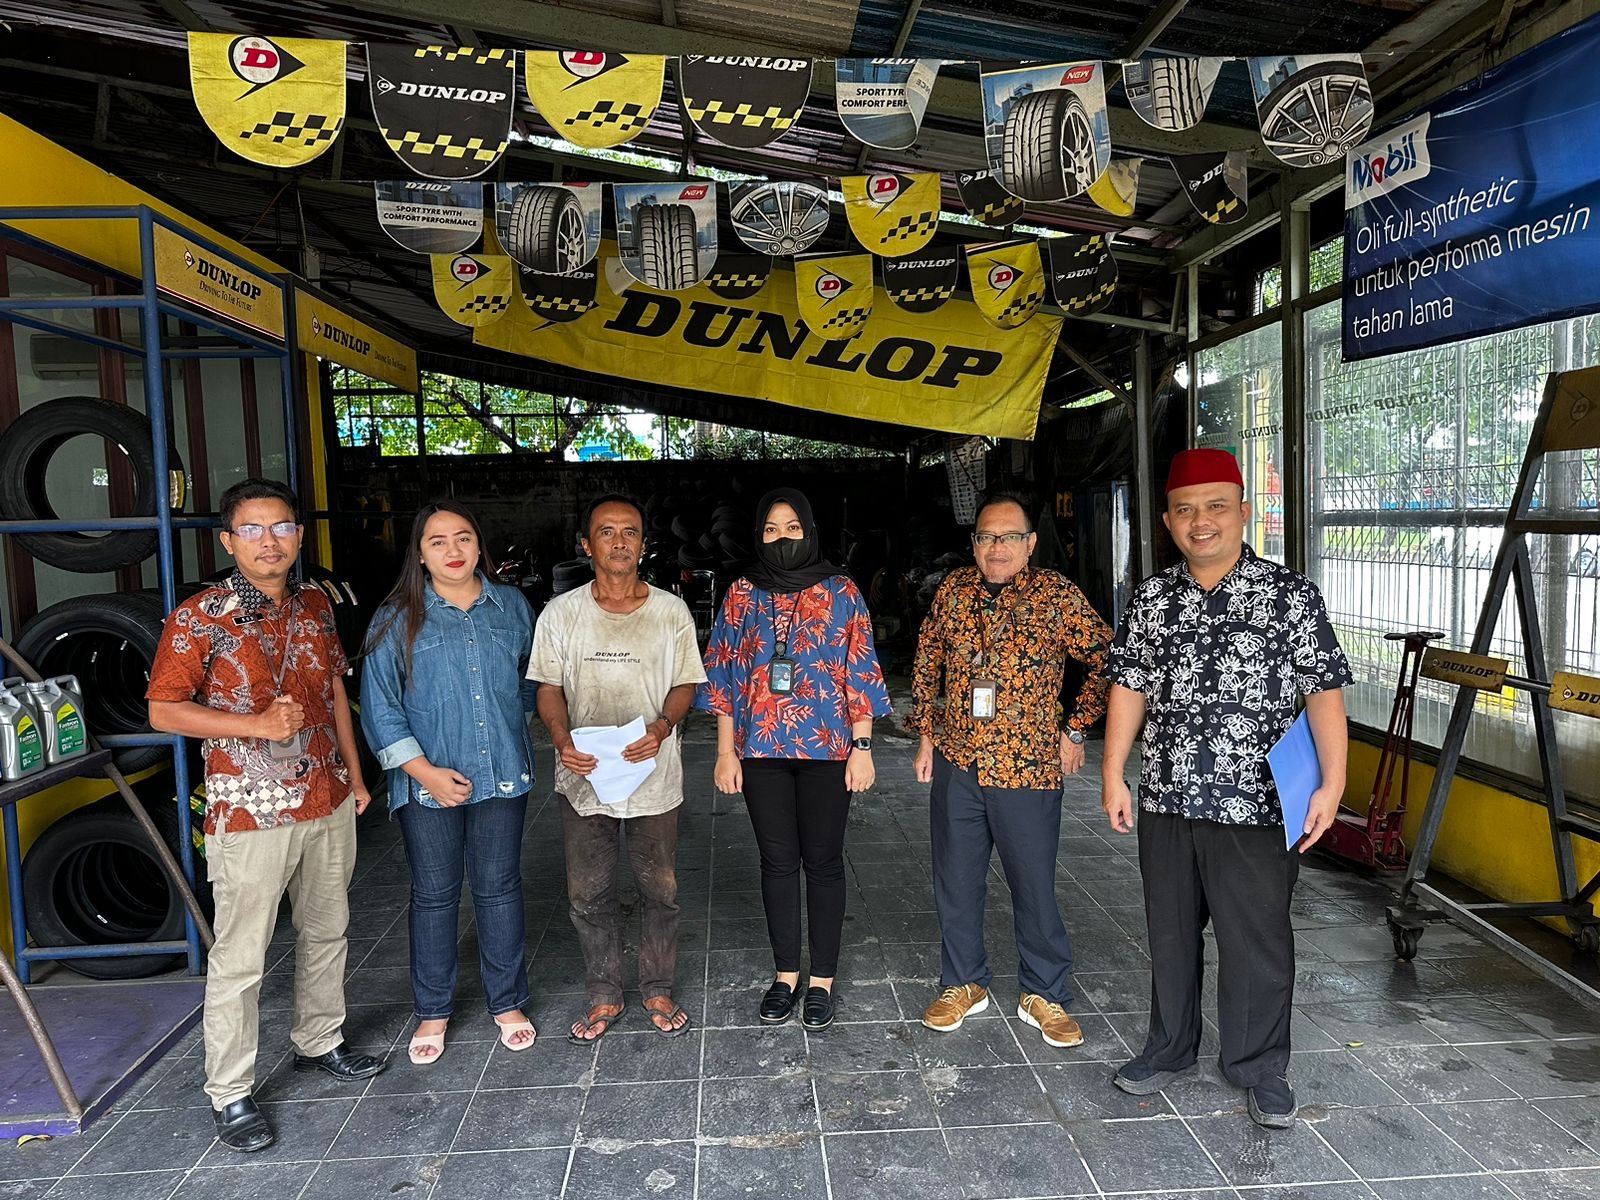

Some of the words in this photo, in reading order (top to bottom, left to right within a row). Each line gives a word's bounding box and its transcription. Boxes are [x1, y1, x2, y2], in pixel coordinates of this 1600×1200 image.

[1066, 70, 1089, 79] NEW
[397, 82, 506, 104] DUNLOP
[841, 99, 885, 107] COMFORT
[856, 88, 886, 96] SPORT
[1353, 132, 1417, 194] Mobil
[383, 212, 420, 221] COMFORT
[421, 216, 477, 227] PERFORMANCE
[396, 205, 421, 213] SPORT
[422, 207, 440, 215] TYRE
[442, 209, 462, 217] WITH
[1357, 221, 1380, 254] Oli
[1384, 176, 1518, 245] full-synthetic
[1355, 262, 1404, 297] untuk
[1408, 233, 1502, 289] performa
[1507, 202, 1592, 251] mesin
[897, 257, 956, 270] DUNLOP
[196, 257, 262, 301] DUNLOP
[1353, 308, 1403, 339] tahan
[1409, 296, 1453, 326] lama
[323, 322, 370, 355] DUNLOP
[604, 289, 1003, 389] DUNLOP
[1440, 660, 1495, 678] DUNLOP
